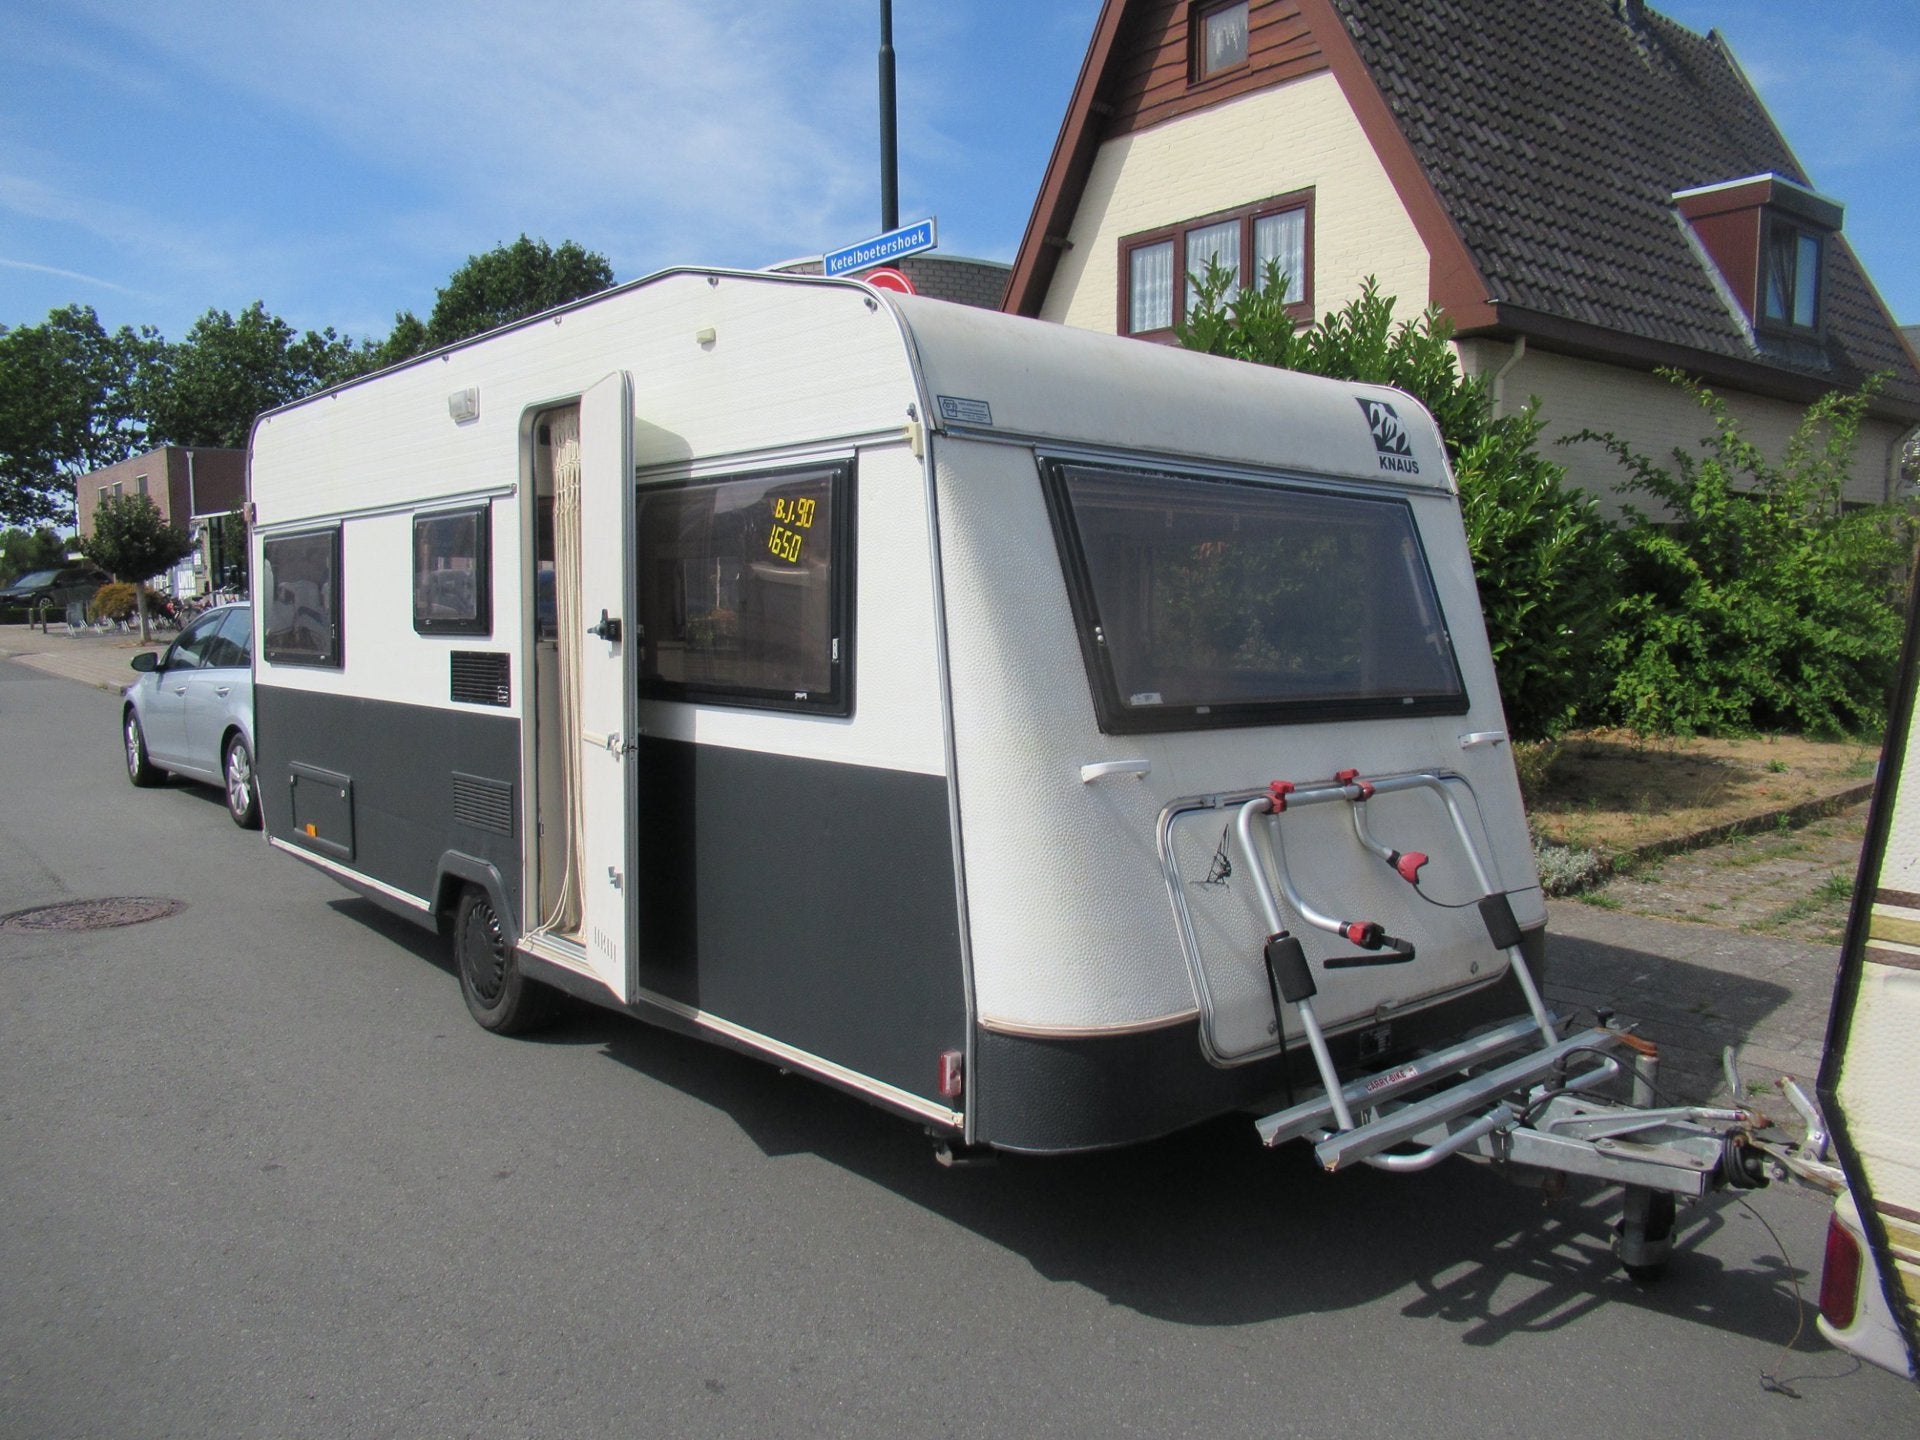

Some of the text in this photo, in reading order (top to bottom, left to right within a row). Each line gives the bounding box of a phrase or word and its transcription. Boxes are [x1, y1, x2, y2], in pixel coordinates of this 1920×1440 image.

[830, 229, 925, 272] Ketelboetershoek
[1379, 455, 1419, 474] KNAUS
[768, 523, 802, 563] 1650
